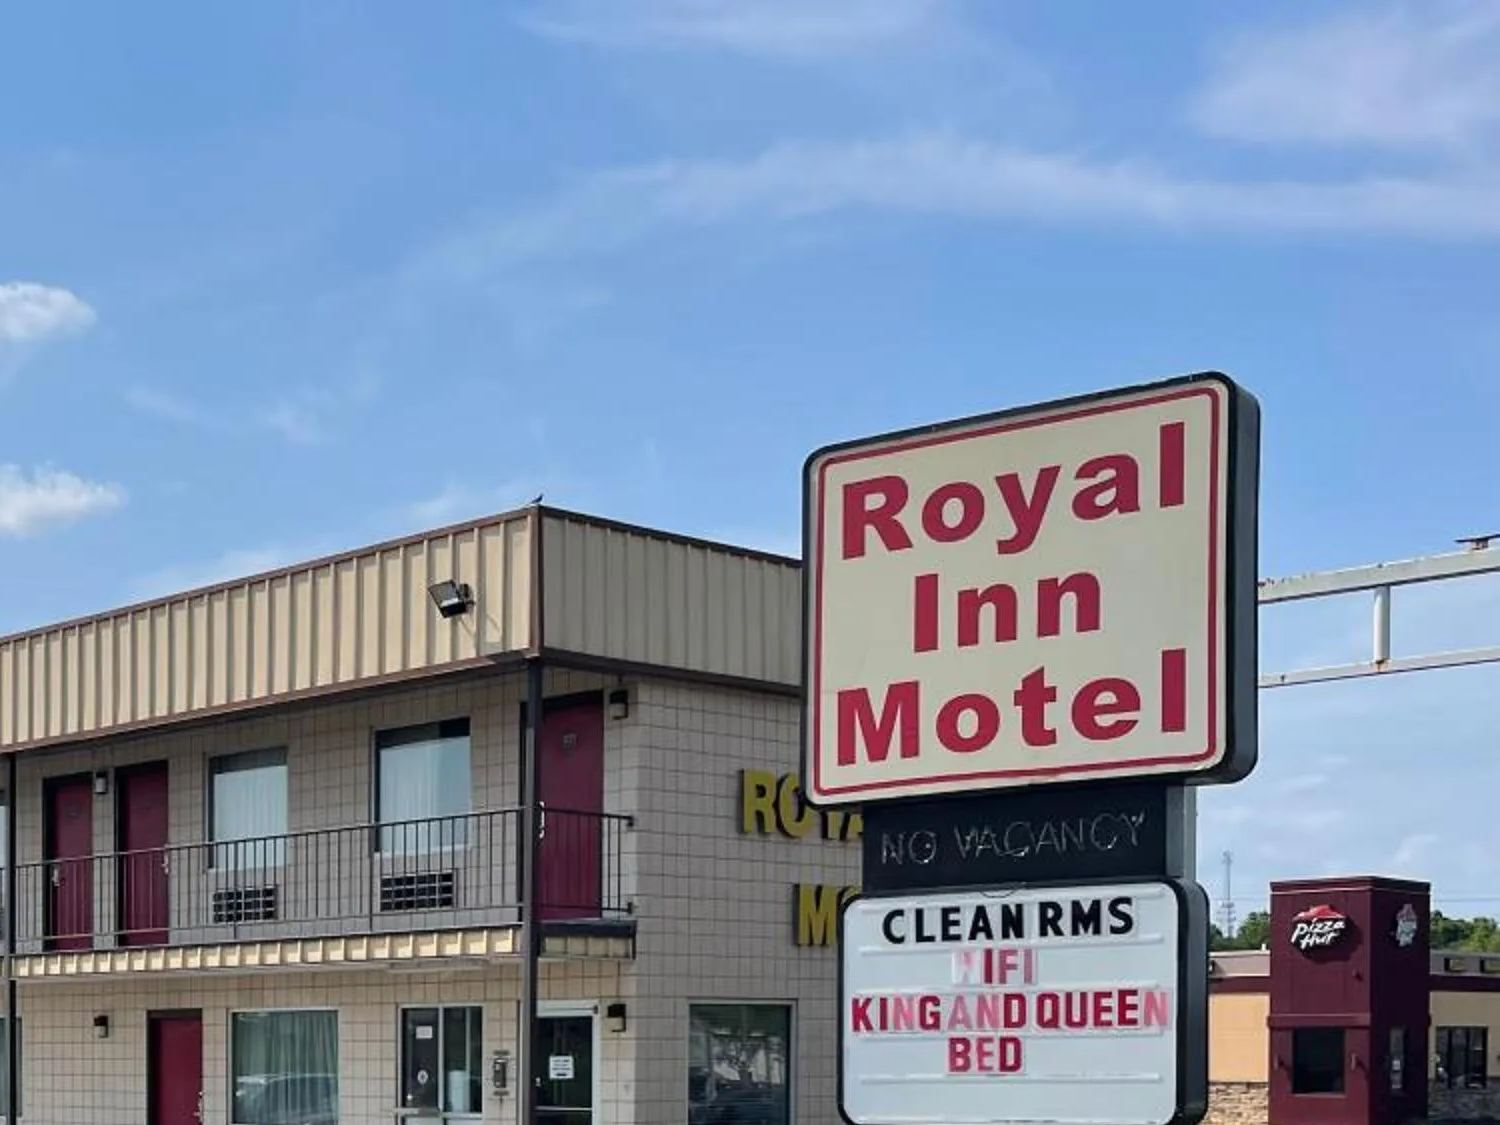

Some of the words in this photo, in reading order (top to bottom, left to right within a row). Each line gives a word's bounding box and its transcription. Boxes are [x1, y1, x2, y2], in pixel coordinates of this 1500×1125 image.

[841, 421, 1186, 560] Royal
[913, 572, 1101, 654] Inn
[836, 648, 1187, 767] Motel
[881, 831, 937, 865] NO
[953, 811, 1146, 860] VACANCY
[882, 903, 1024, 944] CLEAN
[1038, 897, 1134, 939] RMS
[1300, 931, 1341, 950] Hut
[953, 948, 1035, 986] IFI
[948, 1036, 1023, 1073] BED
